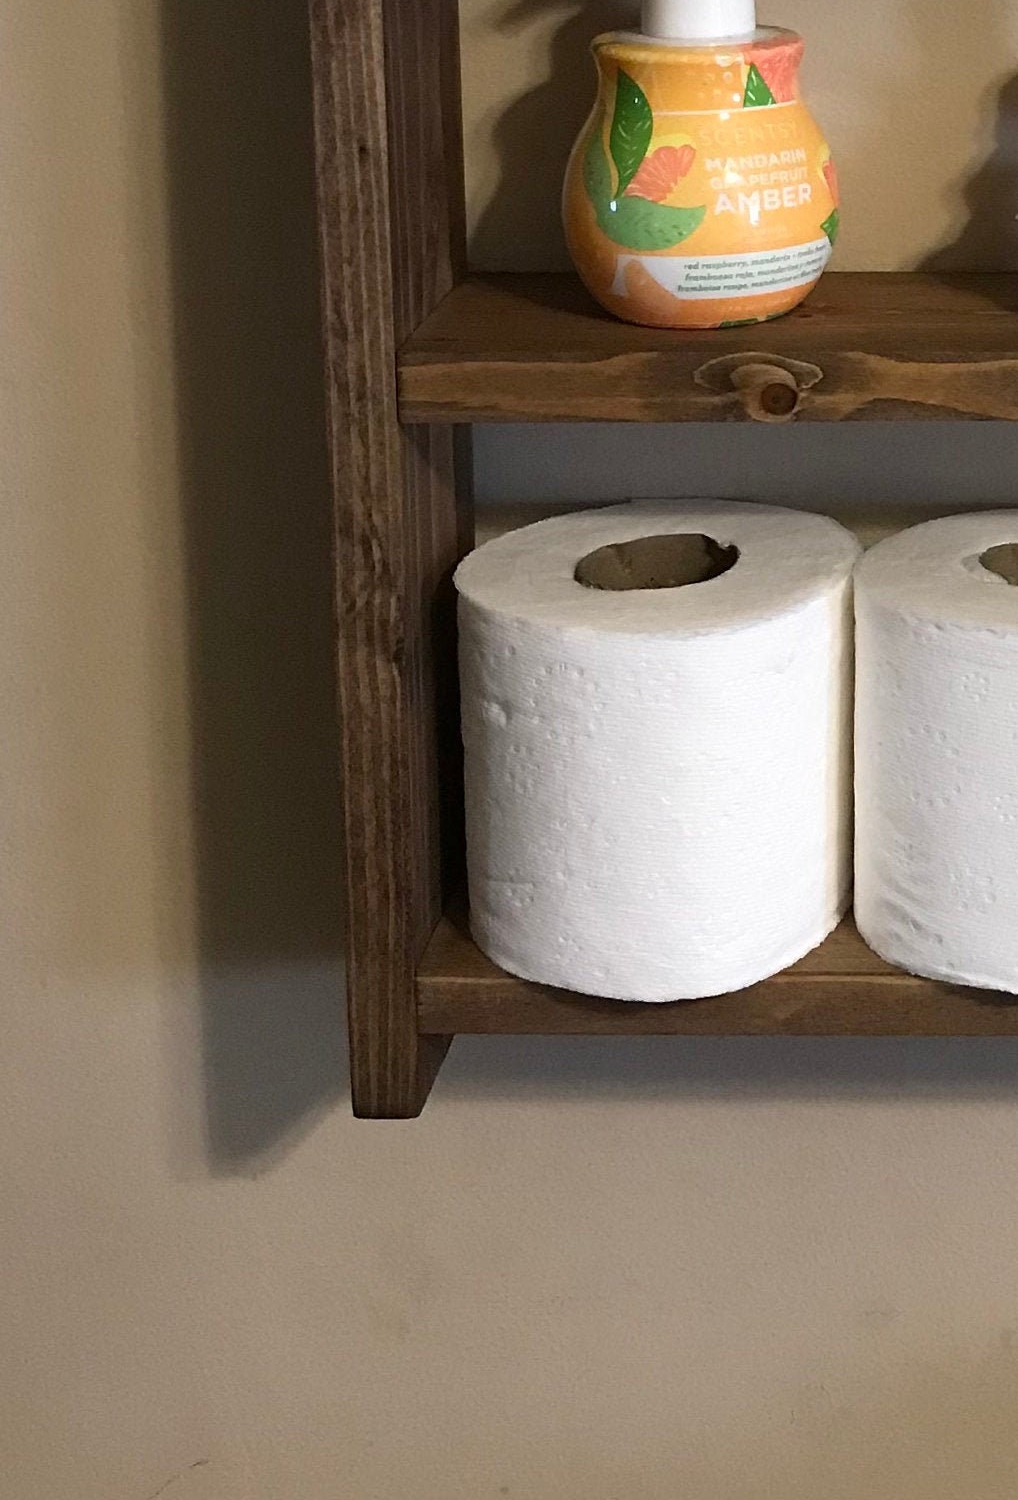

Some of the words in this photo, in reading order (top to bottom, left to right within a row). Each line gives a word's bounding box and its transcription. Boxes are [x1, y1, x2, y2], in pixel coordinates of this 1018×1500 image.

[701, 121, 798, 146] SCENTSY
[705, 148, 807, 171] MANDARIN
[711, 166, 807, 189] GAPEFRUIT
[715, 183, 812, 215] AMBER
[683, 261, 700, 270] red
